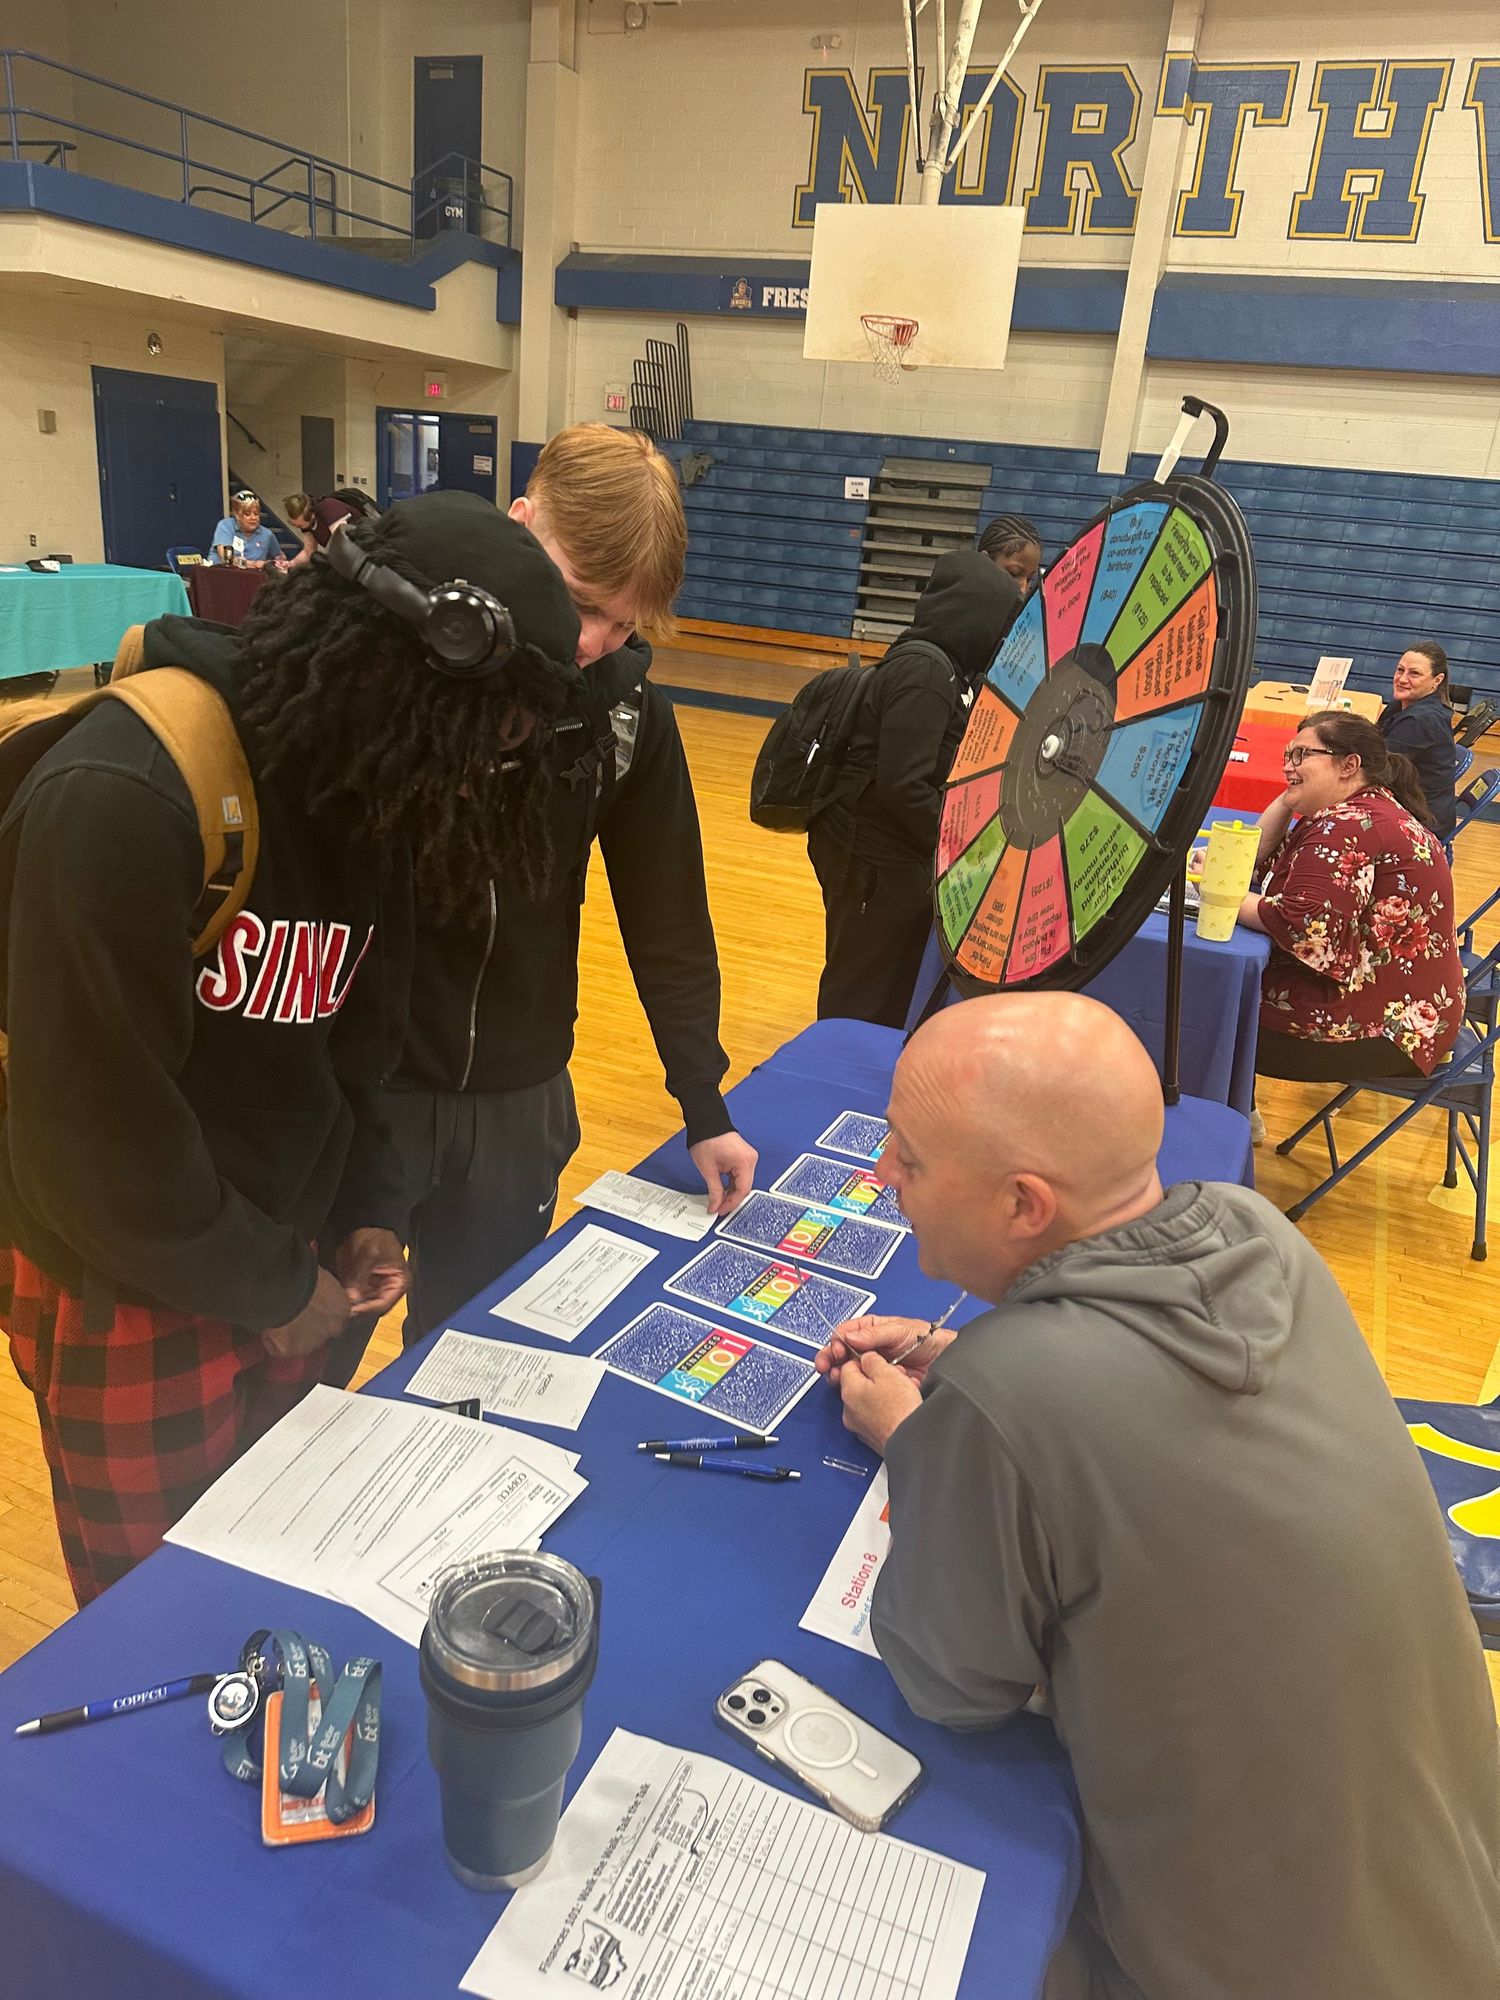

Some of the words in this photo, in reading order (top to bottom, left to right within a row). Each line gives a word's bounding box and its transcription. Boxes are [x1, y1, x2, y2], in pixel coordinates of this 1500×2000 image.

[792, 57, 1500, 245] NORTH
[445, 206, 463, 218] GYM
[1107, 546, 1145, 558] co-worker's
[1187, 551, 1200, 572] work
[1106, 561, 1133, 573] birthday
[1161, 566, 1169, 575] to
[1166, 573, 1174, 586] be
[1175, 560, 1190, 582] need
[1149, 573, 1169, 606] replaced
[1132, 602, 1149, 629] ($125)
[1197, 605, 1207, 630] Cell
[1166, 627, 1174, 664] needs
[1177, 625, 1185, 658] toilet
[1196, 632, 1205, 671] phone
[1155, 643, 1163, 696] replaced
[1165, 665, 1172, 679] to
[1175, 659, 1183, 683] and
[1185, 656, 1193, 678] the
[1164, 680, 1172, 697] be
[1171, 731, 1178, 739] a
[1176, 727, 1190, 753] You
[1130, 745, 1147, 778] $250
[1147, 748, 1163, 781] work
[1155, 743, 1174, 785] bonus
[1148, 788, 1157, 803] at
[1155, 757, 1178, 808] receive
[1080, 825, 1099, 854] $275
[1098, 823, 1121, 856] sends
[1073, 856, 1098, 891] money
[1084, 843, 1118, 891] grandma
[1098, 843, 1129, 888] birthday
[1031, 876, 1053, 897] ($125)
[1082, 888, 1096, 911] and
[986, 913, 1003, 926] dinner
[1027, 911, 1039, 923] tire
[1039, 912, 1062, 930] repair.
[1040, 903, 1055, 916] new
[973, 920, 989, 934] buying
[1024, 927, 1036, 938] Buy
[1022, 933, 1048, 954] beyond
[747, 1266, 781, 1297] FINANCES
[758, 1269, 799, 1307] 101
[680, 1334, 721, 1372] FINANCES
[694, 1338, 746, 1380] 101
[841, 1564, 874, 1609] Station
[863, 1552, 878, 1564] 8
[112, 1686, 168, 1710] COPFCU
[703, 1817, 721, 1840] Balance
[537, 1925, 571, 1974] Finances
[563, 1901, 584, 1927] 101:
[576, 1875, 599, 1904] Walk
[591, 1858, 608, 1878] the
[600, 1831, 624, 1861] Walk,
[615, 1813, 633, 1834] Talk
[626, 1798, 641, 1815] the
[634, 1780, 651, 1800] Talk
[683, 1858, 703, 1883] Deposit
[606, 1883, 629, 1920] Occupation
[629, 1905, 647, 1932] Student
[643, 1890, 654, 1906] Loan
[650, 1863, 668, 1890] Payment
[637, 1915, 651, 1936] Credit
[647, 1899, 659, 1916] Card
[655, 1884, 666, 1900] Debt
